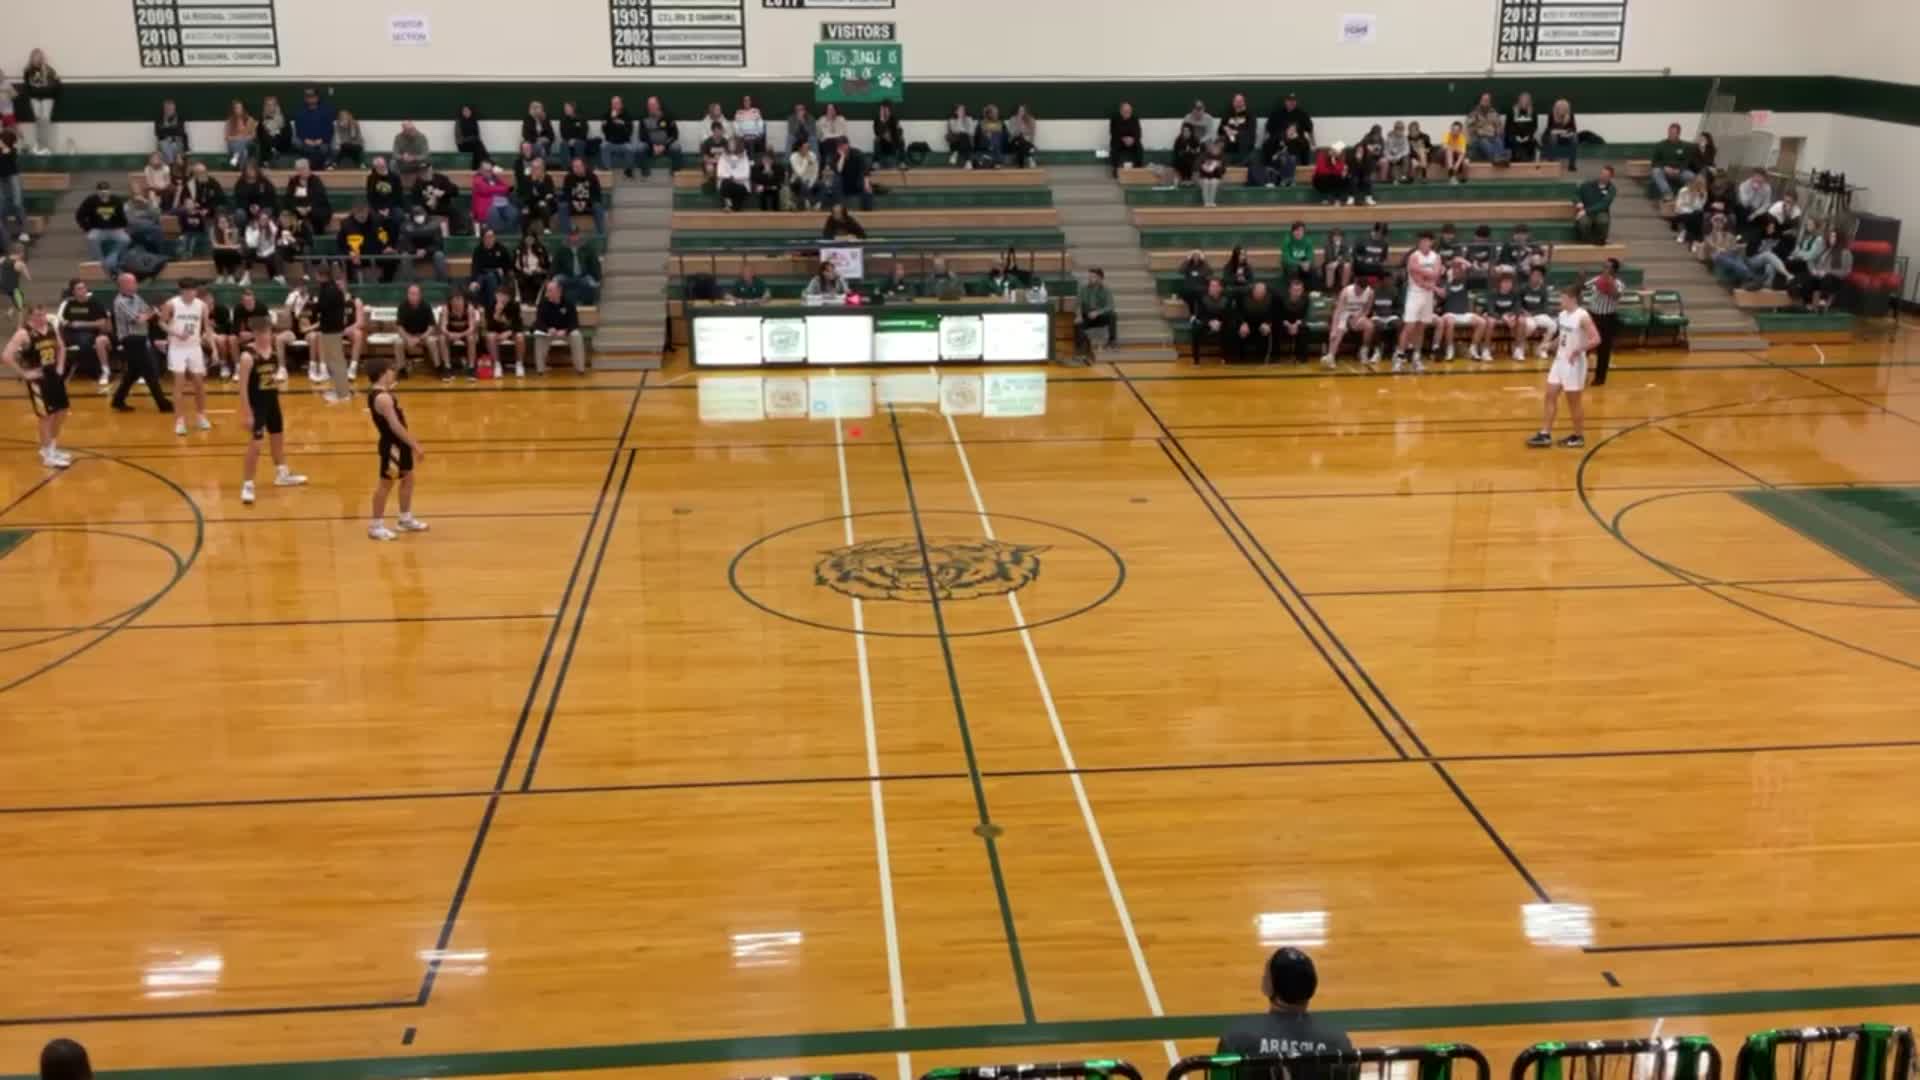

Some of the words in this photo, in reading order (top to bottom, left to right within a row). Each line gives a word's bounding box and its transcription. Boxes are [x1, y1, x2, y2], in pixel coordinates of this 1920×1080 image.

[137, 8, 175, 25] 2009
[613, 8, 649, 26] 1995
[1503, 7, 1537, 23] 2013
[140, 28, 178, 46] 2010
[614, 28, 649, 46] 2002
[827, 24, 891, 39] VISITORS
[1501, 26, 1535, 43] 2013
[142, 49, 180, 66] 2010
[825, 49, 847, 66] THIS
[850, 49, 882, 67] JUNGLE
[1499, 45, 1532, 62] 2014
